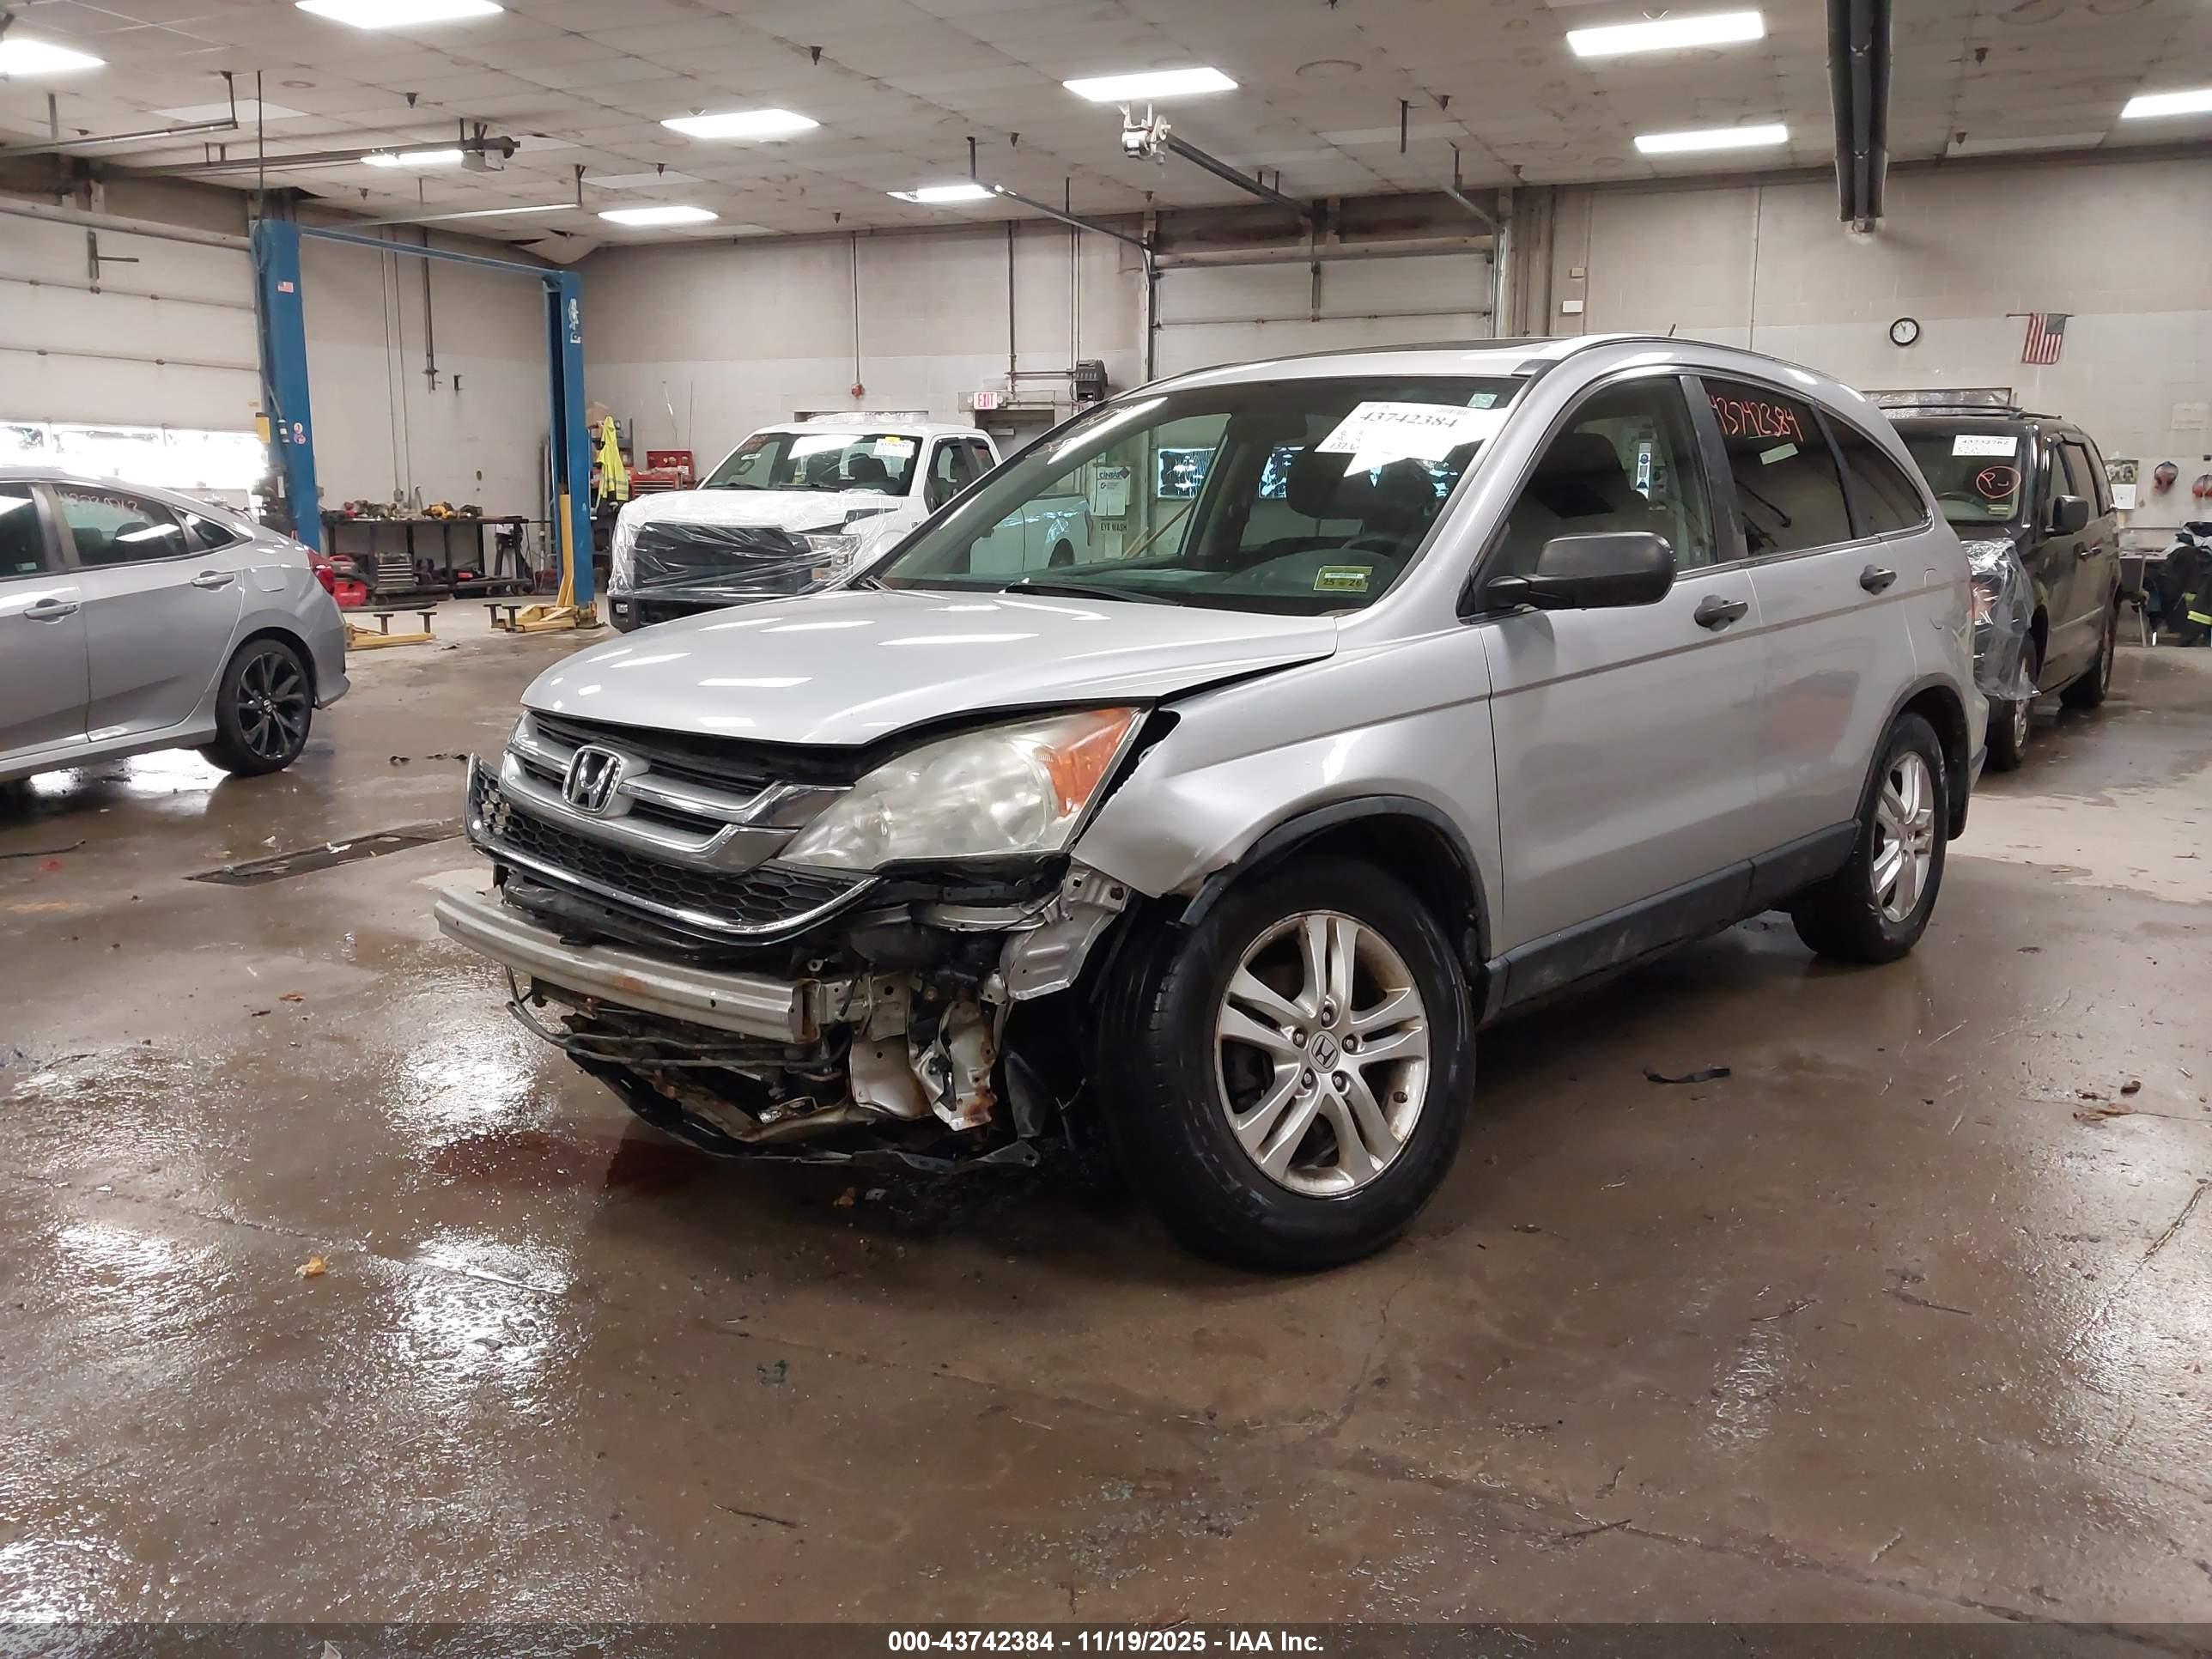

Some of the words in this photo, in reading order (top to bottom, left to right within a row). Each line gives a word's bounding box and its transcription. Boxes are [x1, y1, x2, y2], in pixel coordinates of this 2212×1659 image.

[977, 392, 994, 408] EXIT
[1359, 412, 1459, 428] 43742384
[1706, 394, 1804, 442] 43742384
[1100, 521, 1110, 531] EYE
[1112, 522, 1127, 532] WASH
